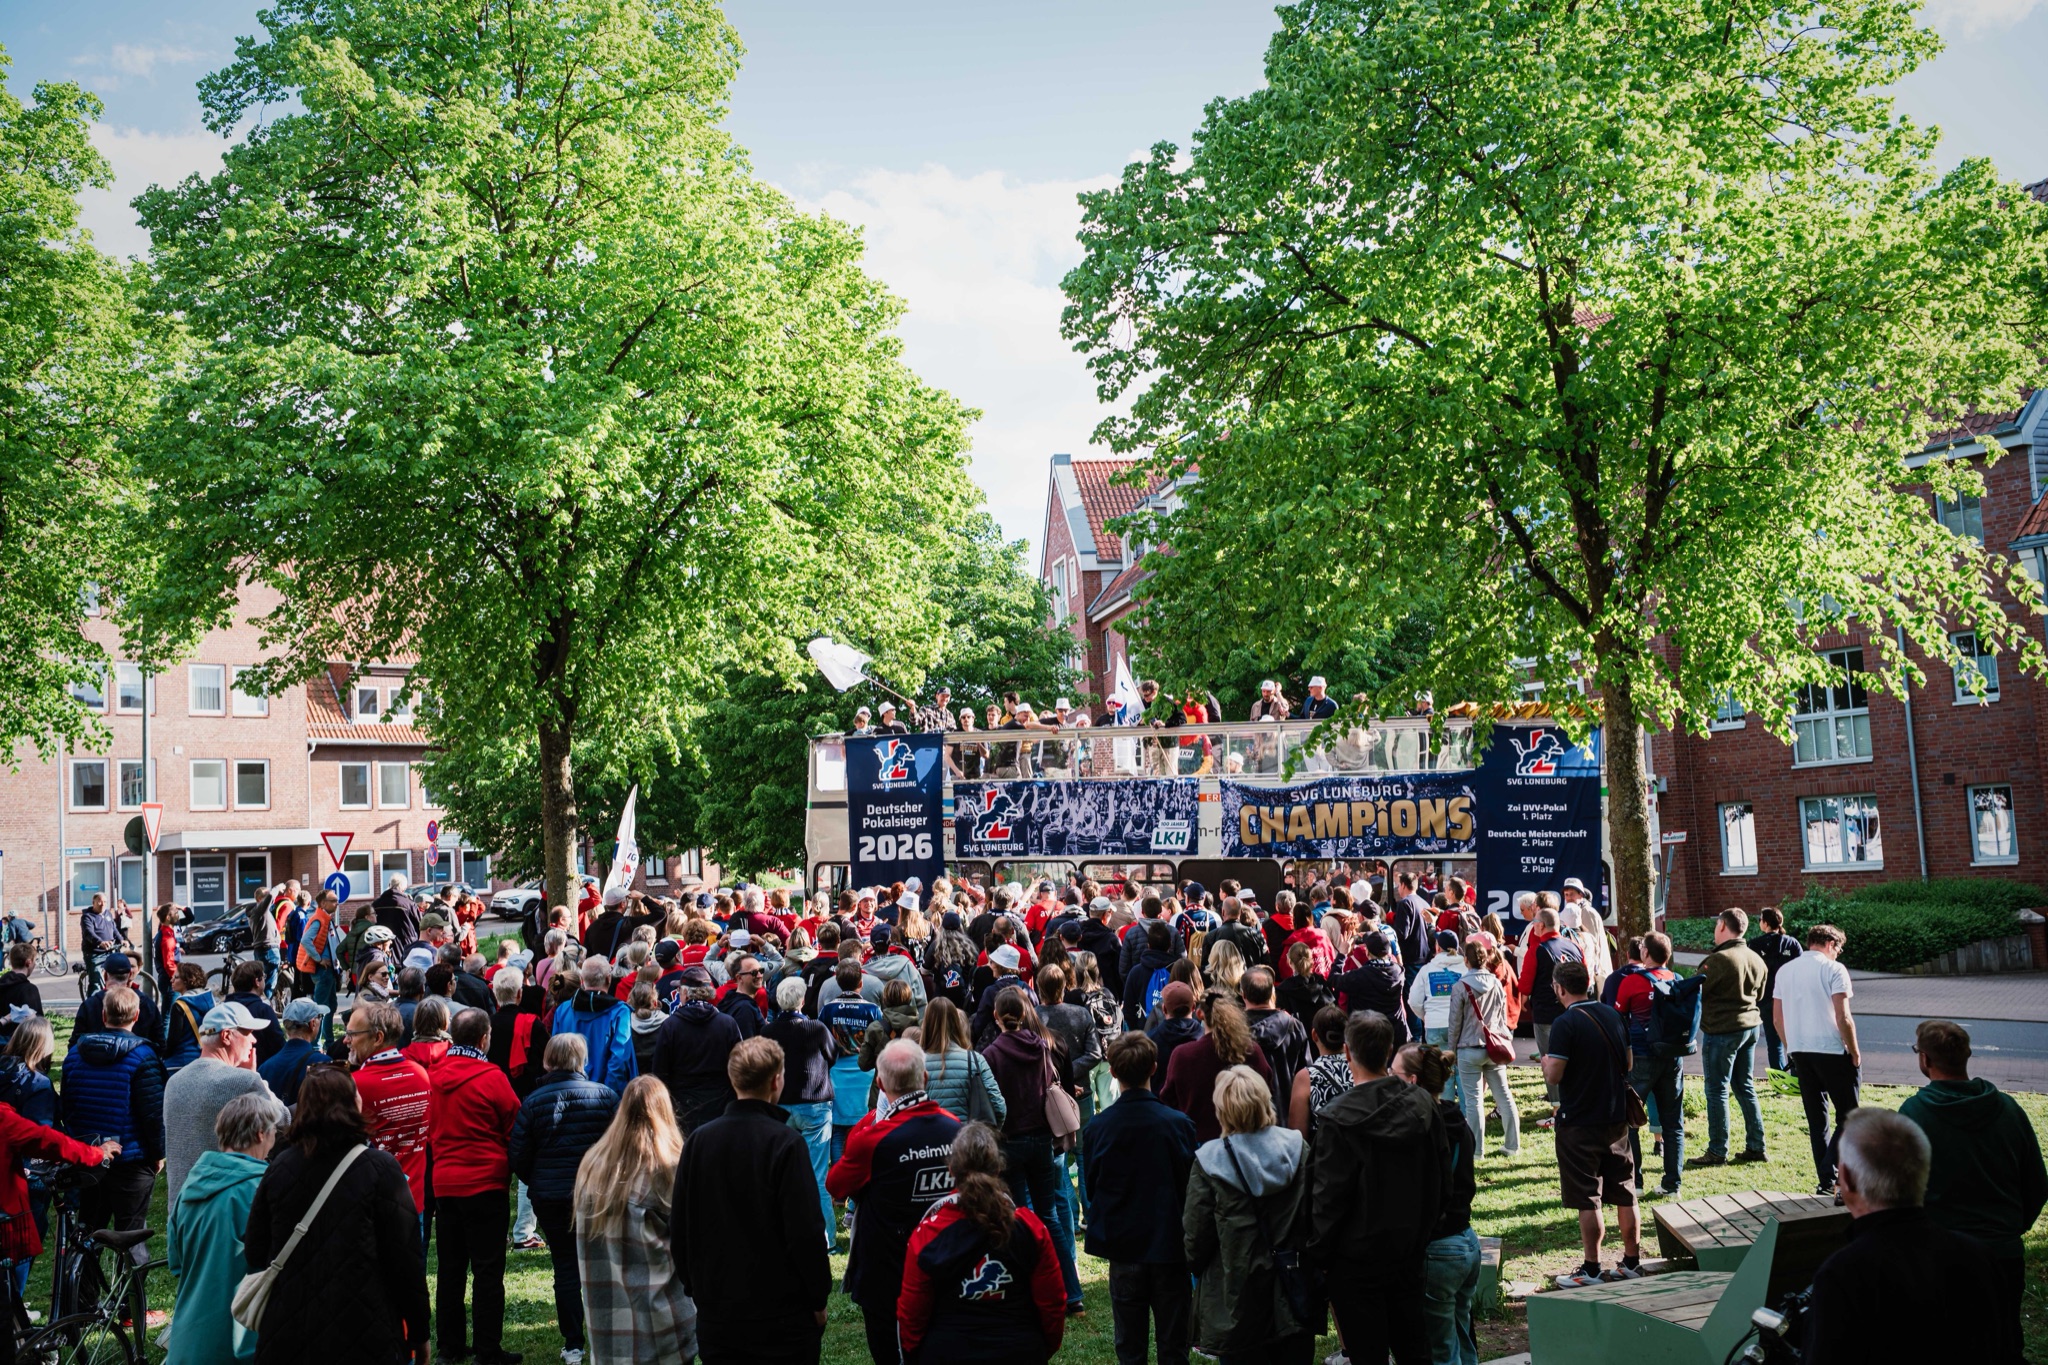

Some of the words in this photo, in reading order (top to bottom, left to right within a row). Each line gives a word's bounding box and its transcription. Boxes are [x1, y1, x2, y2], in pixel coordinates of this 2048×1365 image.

[1290, 789, 1318, 802] SVG
[1323, 784, 1402, 799] LÜNEBURG
[866, 801, 923, 815] Deutscher
[1507, 804, 1521, 812] Zoi
[1523, 804, 1567, 812] DVV-Pokal
[862, 815, 928, 829] Pokalsieger
[1154, 831, 1186, 845] LKH
[1488, 830, 1527, 838] Deutsche
[1528, 829, 1587, 838] Meisterschaft
[859, 833, 933, 862] 2026
[1522, 839, 1530, 847] 2.
[1532, 839, 1554, 847] Platz
[1520, 856, 1537, 864] CEV
[1539, 857, 1555, 866] Cup
[1522, 865, 1530, 873] 2.
[1532, 865, 1554, 873] Platz
[919, 1171, 956, 1192] LKH
